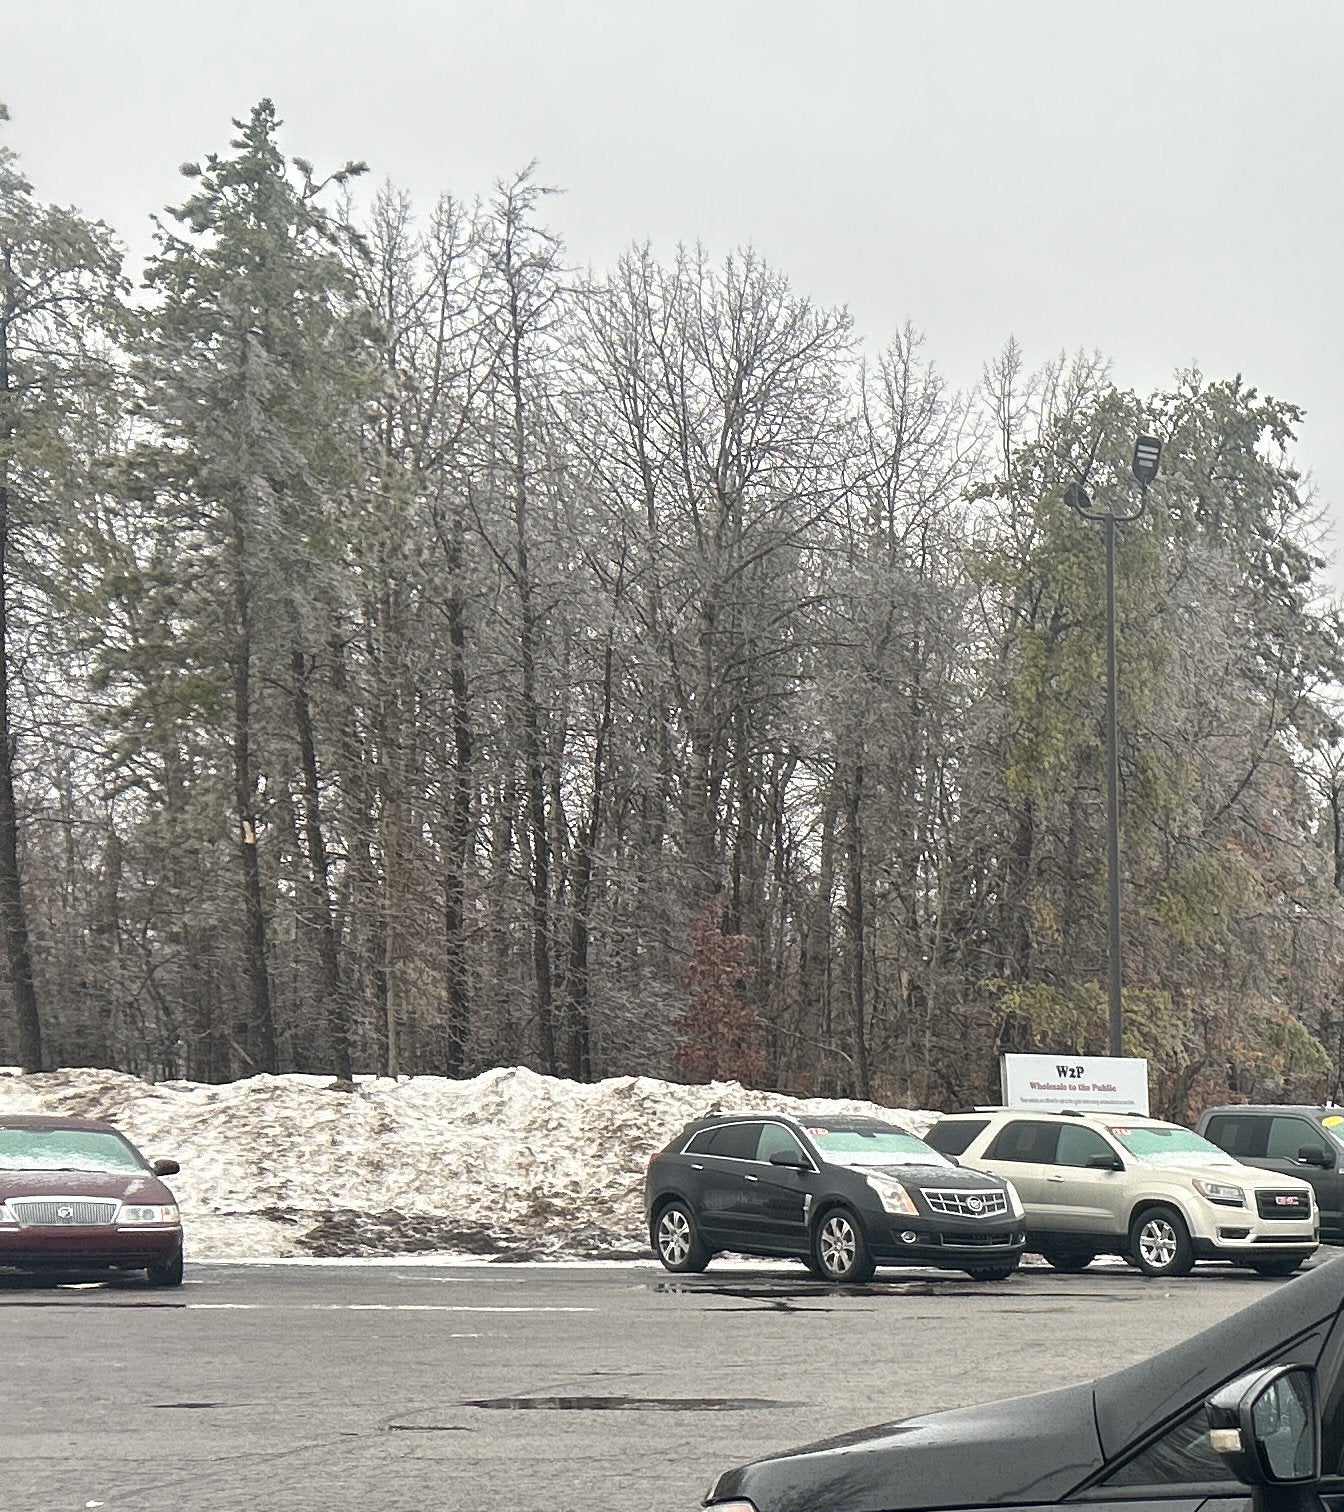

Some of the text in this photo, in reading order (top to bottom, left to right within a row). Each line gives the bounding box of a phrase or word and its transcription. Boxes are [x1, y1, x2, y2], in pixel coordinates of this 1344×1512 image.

[1056, 1065, 1084, 1079] W2P
[1029, 1081, 1117, 1092] Wholesale to the Public
